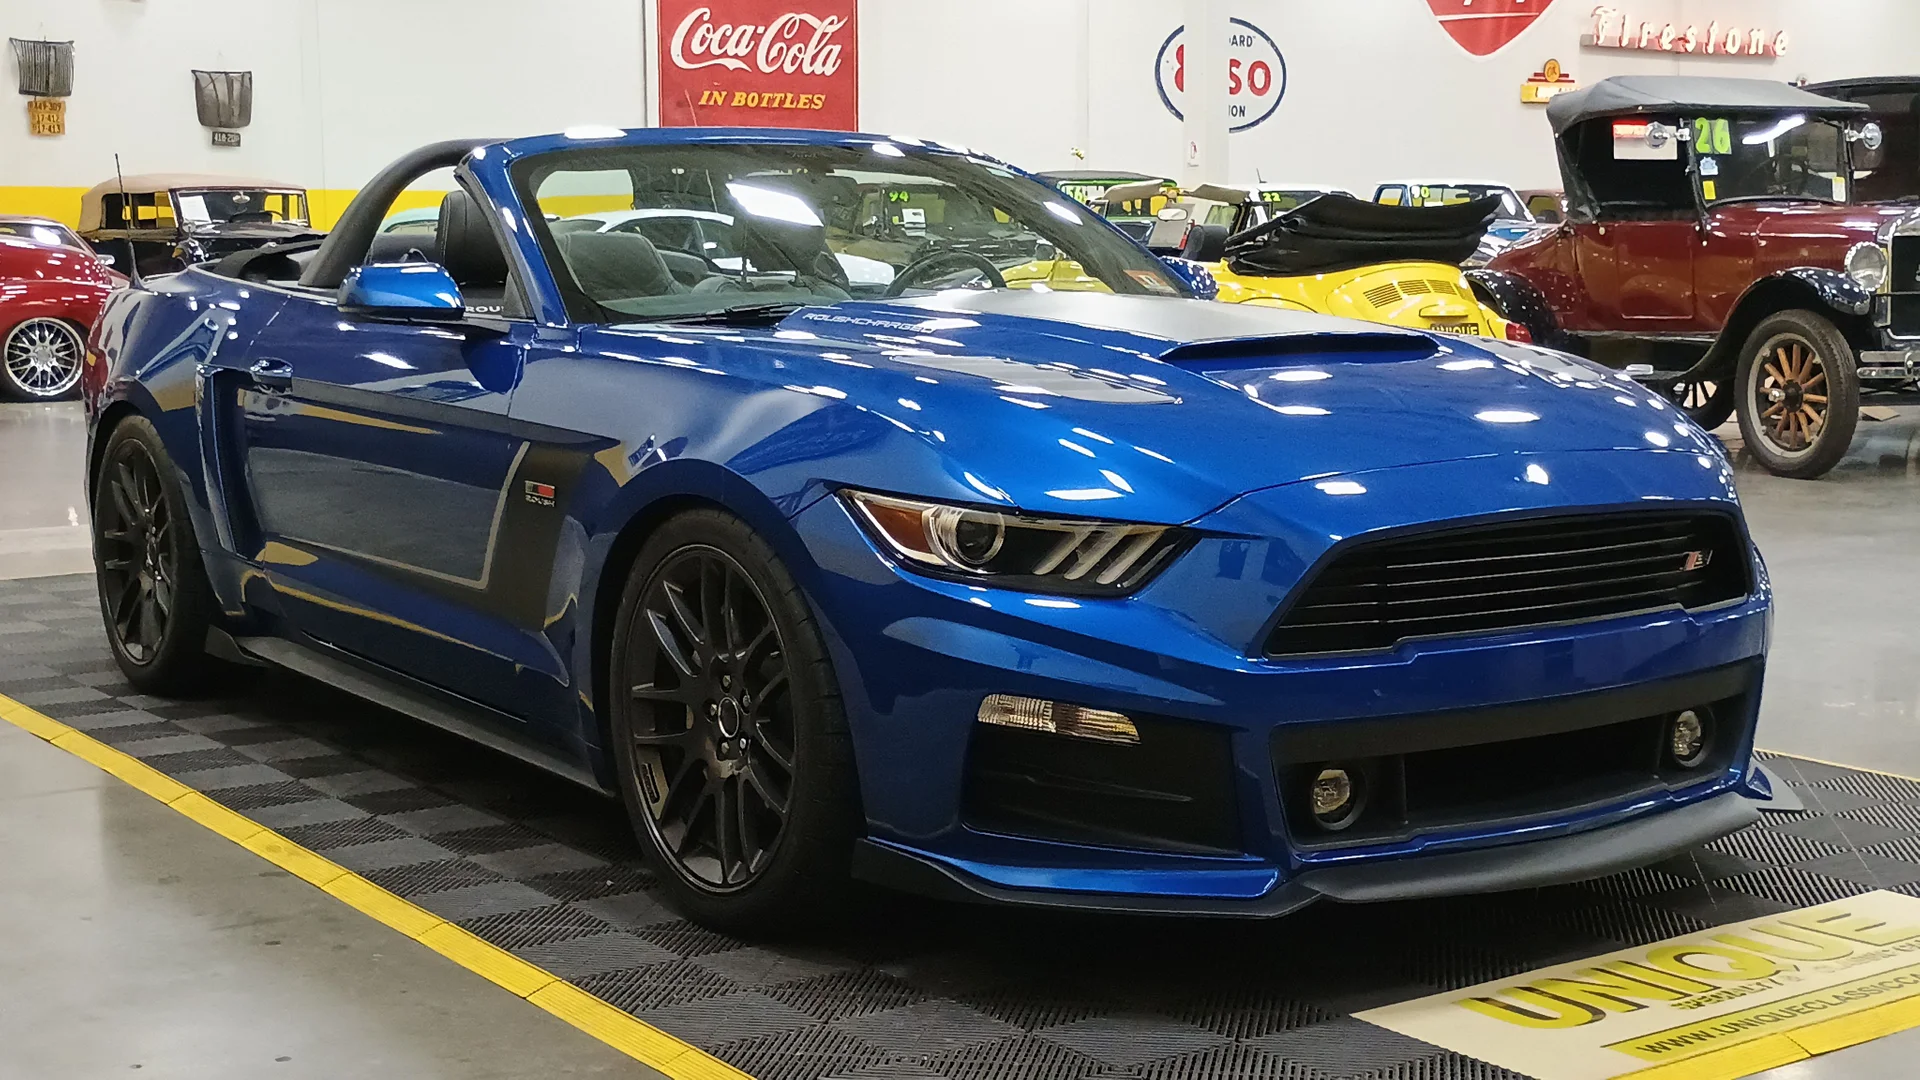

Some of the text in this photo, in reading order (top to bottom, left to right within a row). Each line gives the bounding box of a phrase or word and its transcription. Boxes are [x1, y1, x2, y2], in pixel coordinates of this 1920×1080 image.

[1229, 34, 1253, 48] ARD
[1591, 5, 1789, 57] Firestone
[670, 7, 849, 76] Coca-Cola
[698, 90, 826, 110] IN BOTTLES
[1229, 104, 1246, 118] ON
[1695, 117, 1730, 154] 26
[889, 191, 909, 202] 94
[465, 305, 505, 313] ROU
[1455, 910, 1920, 1029] UNIQUE
